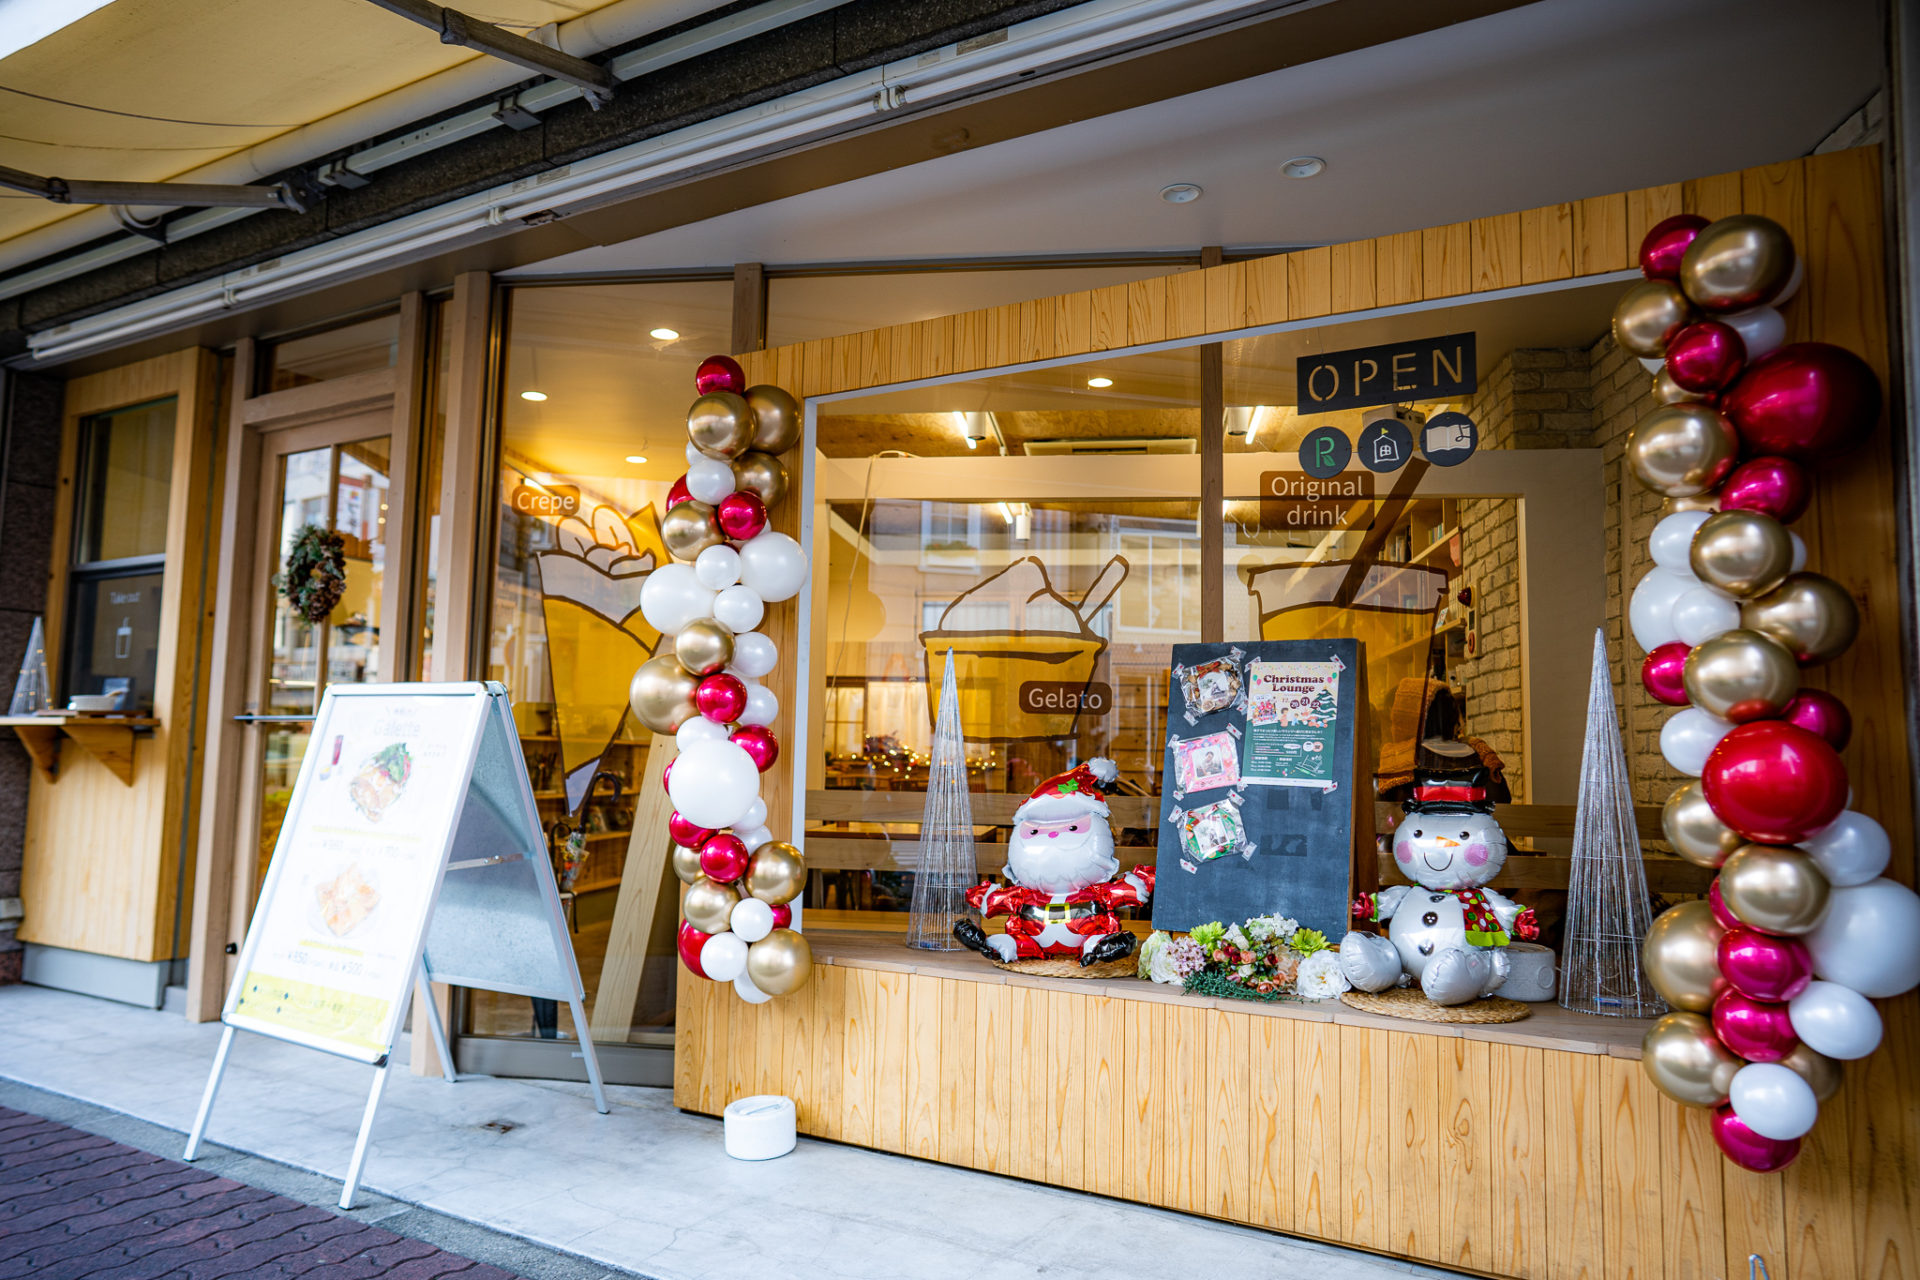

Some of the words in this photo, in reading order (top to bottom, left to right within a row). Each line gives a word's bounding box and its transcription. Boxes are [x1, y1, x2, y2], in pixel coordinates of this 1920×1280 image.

[1308, 346, 1462, 402] OPEN
[1271, 476, 1364, 502] Original
[517, 492, 575, 514] Crepe
[1287, 505, 1348, 525] drink
[1263, 674, 1324, 683] Christmas
[1272, 684, 1315, 694] Lounge
[1028, 687, 1102, 709] Gelato
